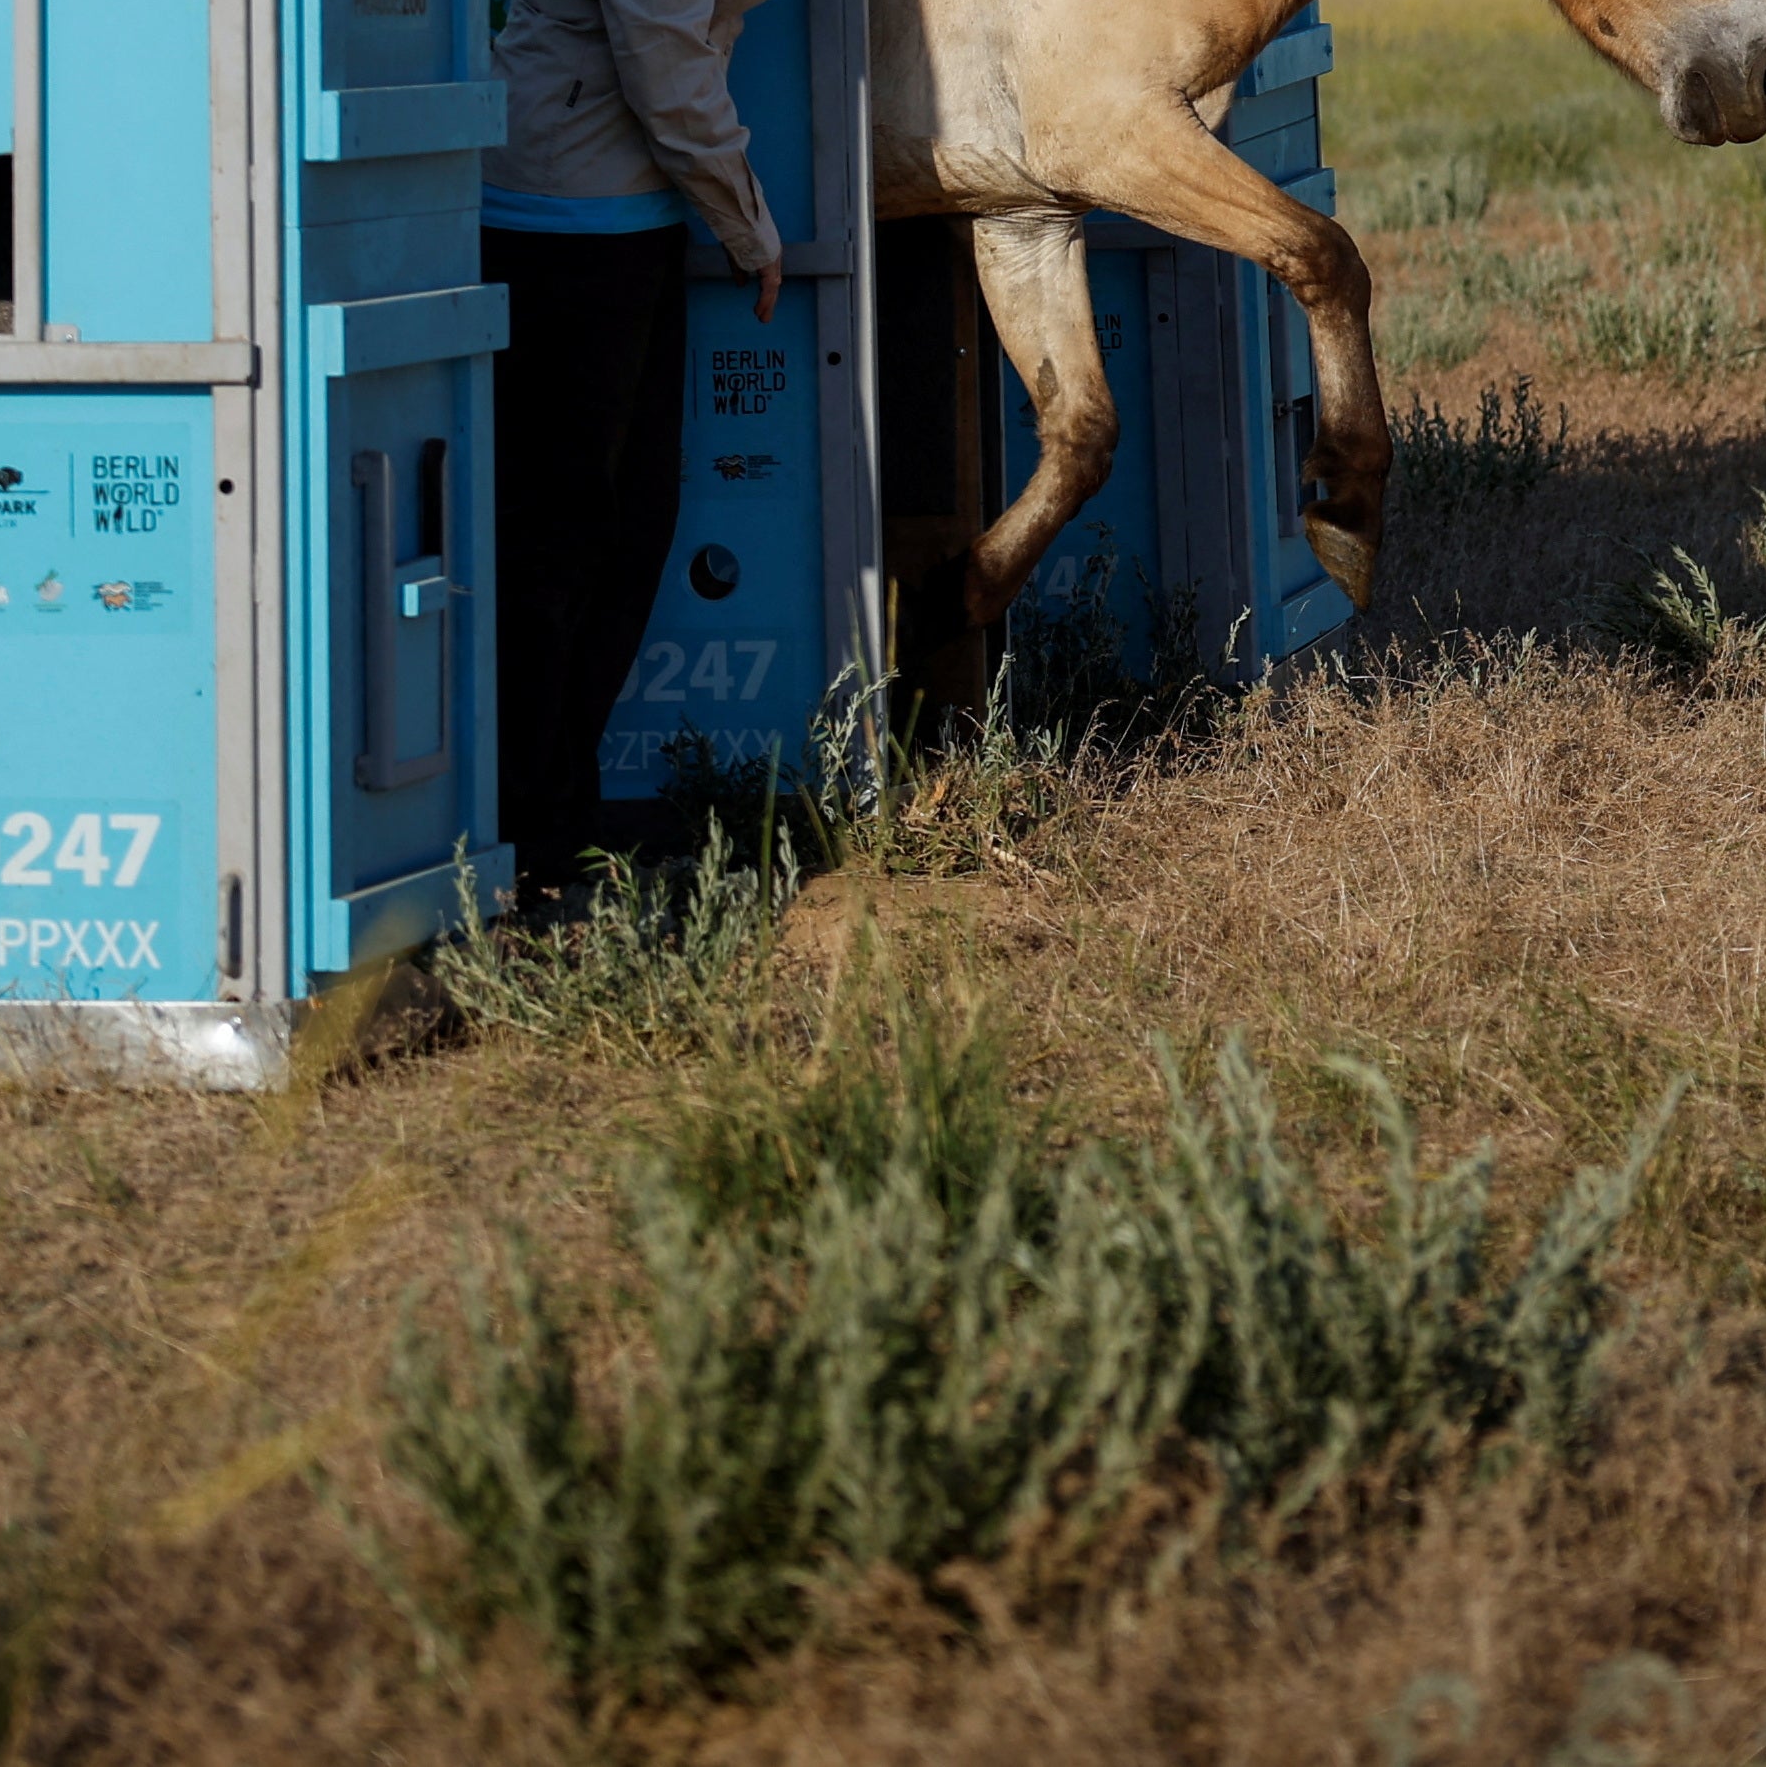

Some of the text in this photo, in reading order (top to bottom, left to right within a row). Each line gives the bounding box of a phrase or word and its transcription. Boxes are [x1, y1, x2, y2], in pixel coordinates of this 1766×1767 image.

[713, 349, 785, 370] BERLIN
[713, 371, 786, 392] WORLD
[92, 455, 179, 479] BERLIN
[93, 483, 180, 506] WORLD
